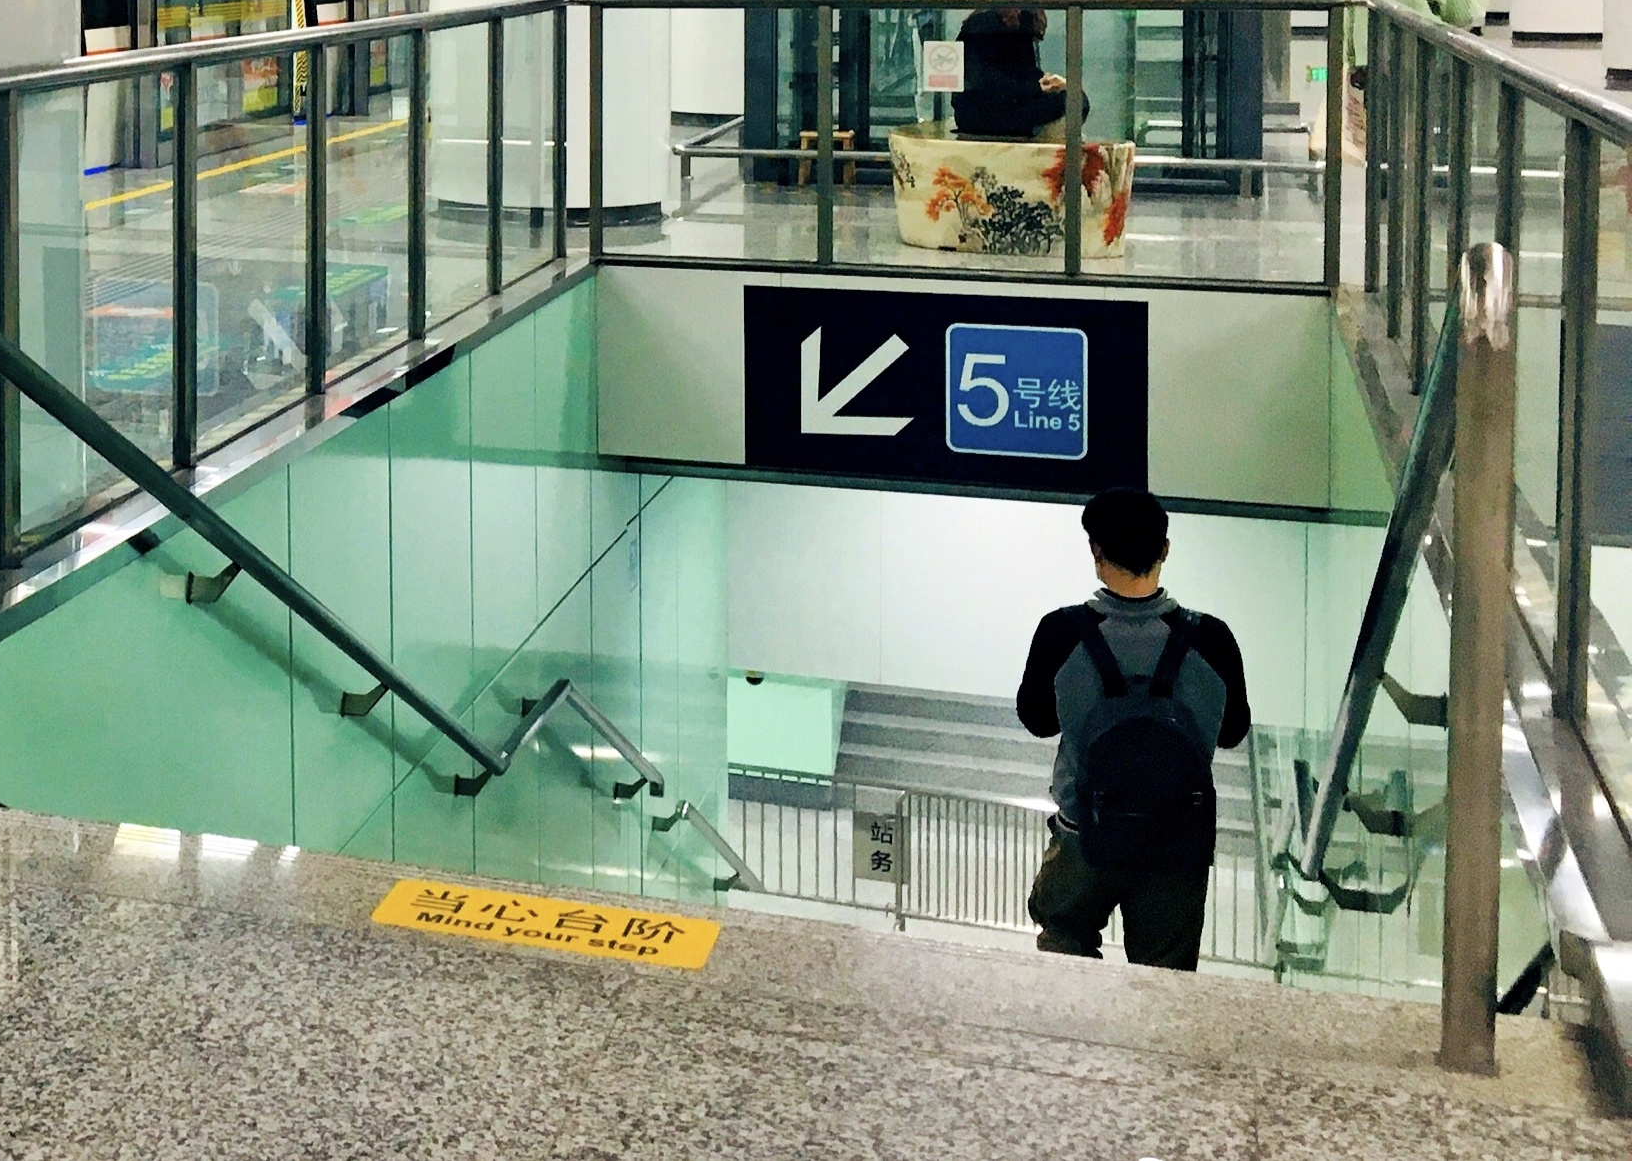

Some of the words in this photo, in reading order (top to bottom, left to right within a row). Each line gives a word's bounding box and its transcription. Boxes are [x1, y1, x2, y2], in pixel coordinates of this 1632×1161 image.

[1014, 410, 1062, 430] Line
[1068, 414, 1081, 431] 5
[871, 822, 893, 872] 站务
[410, 889, 685, 945] 当心台阶
[416, 911, 495, 932] Mind
[503, 926, 580, 944] your
[587, 936, 659, 956] step
